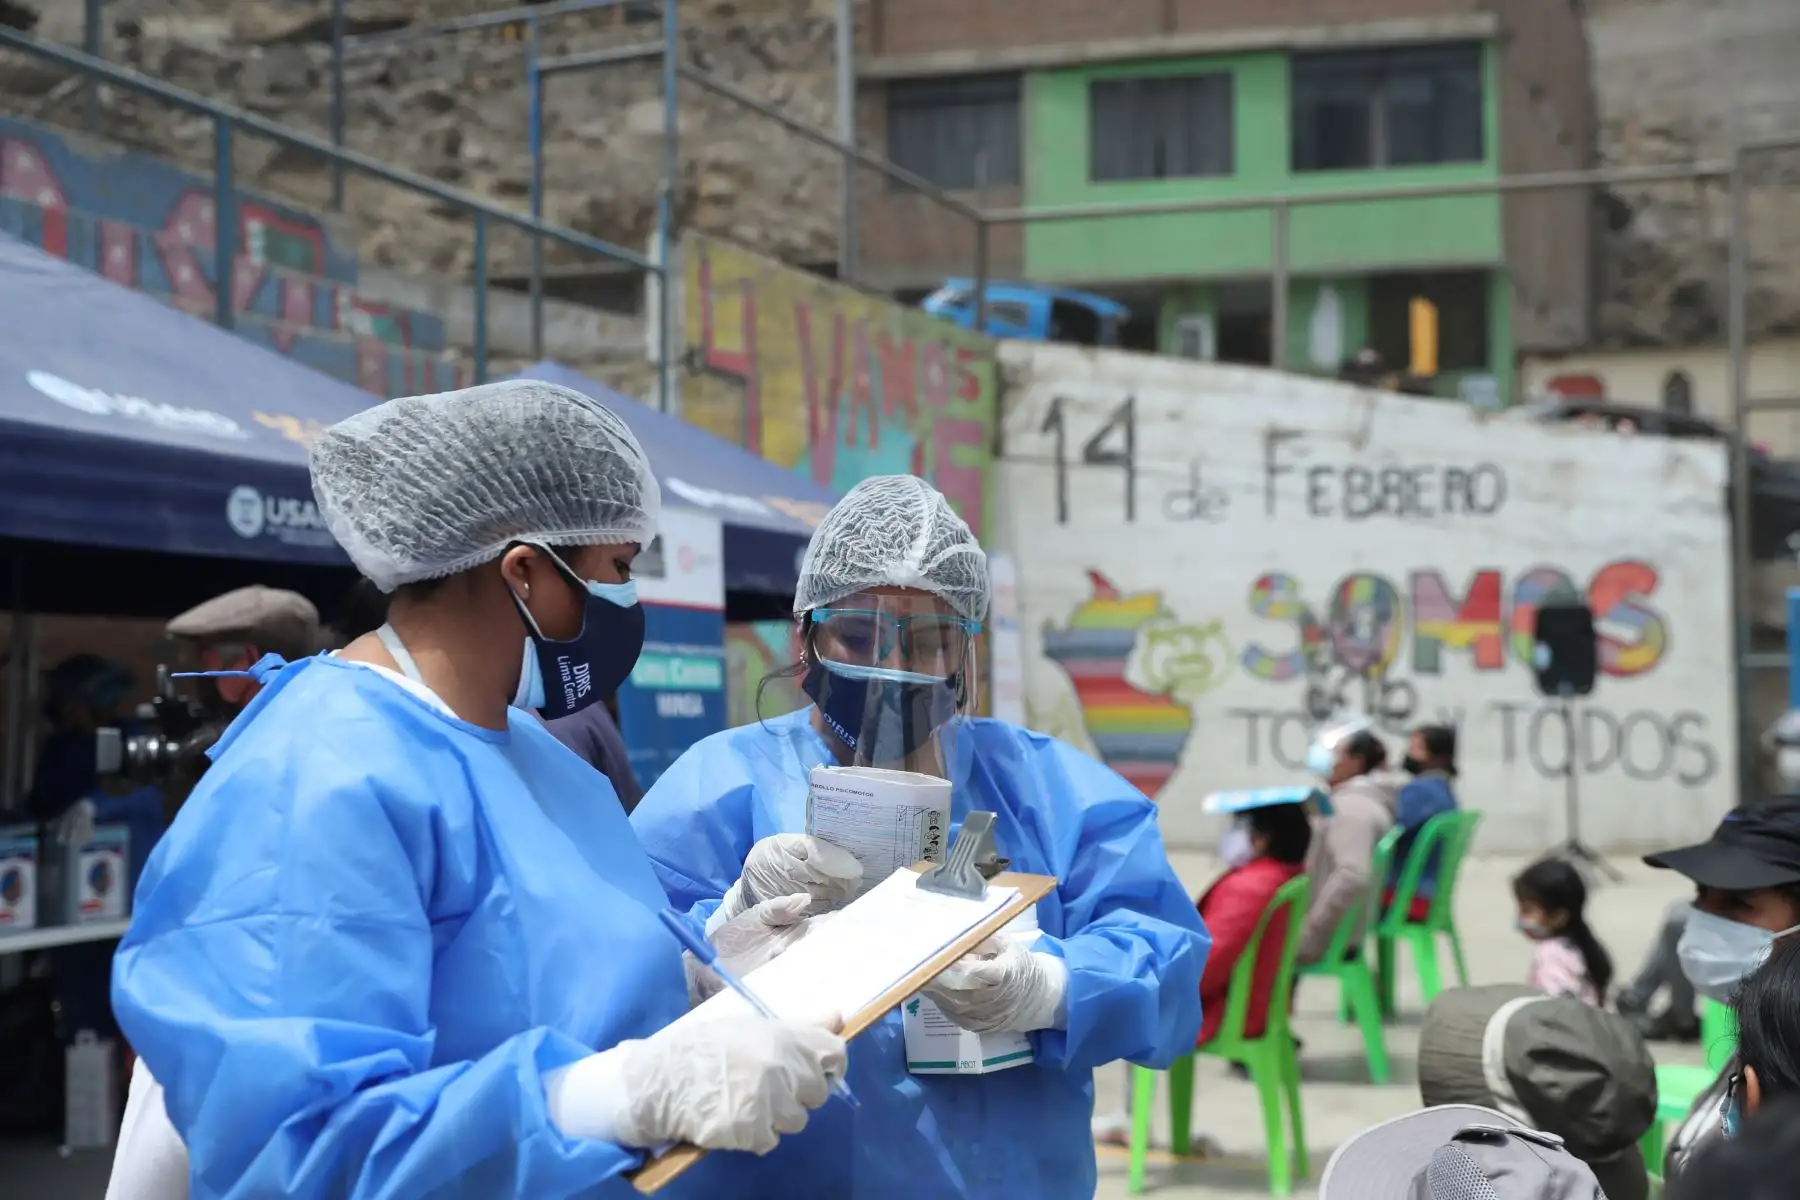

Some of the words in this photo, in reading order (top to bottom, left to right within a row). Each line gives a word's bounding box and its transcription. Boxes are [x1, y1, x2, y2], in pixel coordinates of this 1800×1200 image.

[1040, 394, 1136, 527] 14
[1162, 452, 1231, 525] de
[1264, 427, 1508, 520] FEBRERO
[266, 496, 330, 528] USA
[1240, 559, 1667, 681] SOMOS
[557, 655, 571, 682] Lima
[564, 682, 577, 709] Centro
[573, 662, 591, 698] DIRIS
[823, 712, 858, 746] DIRIS
[1491, 701, 1719, 788] TODOS
